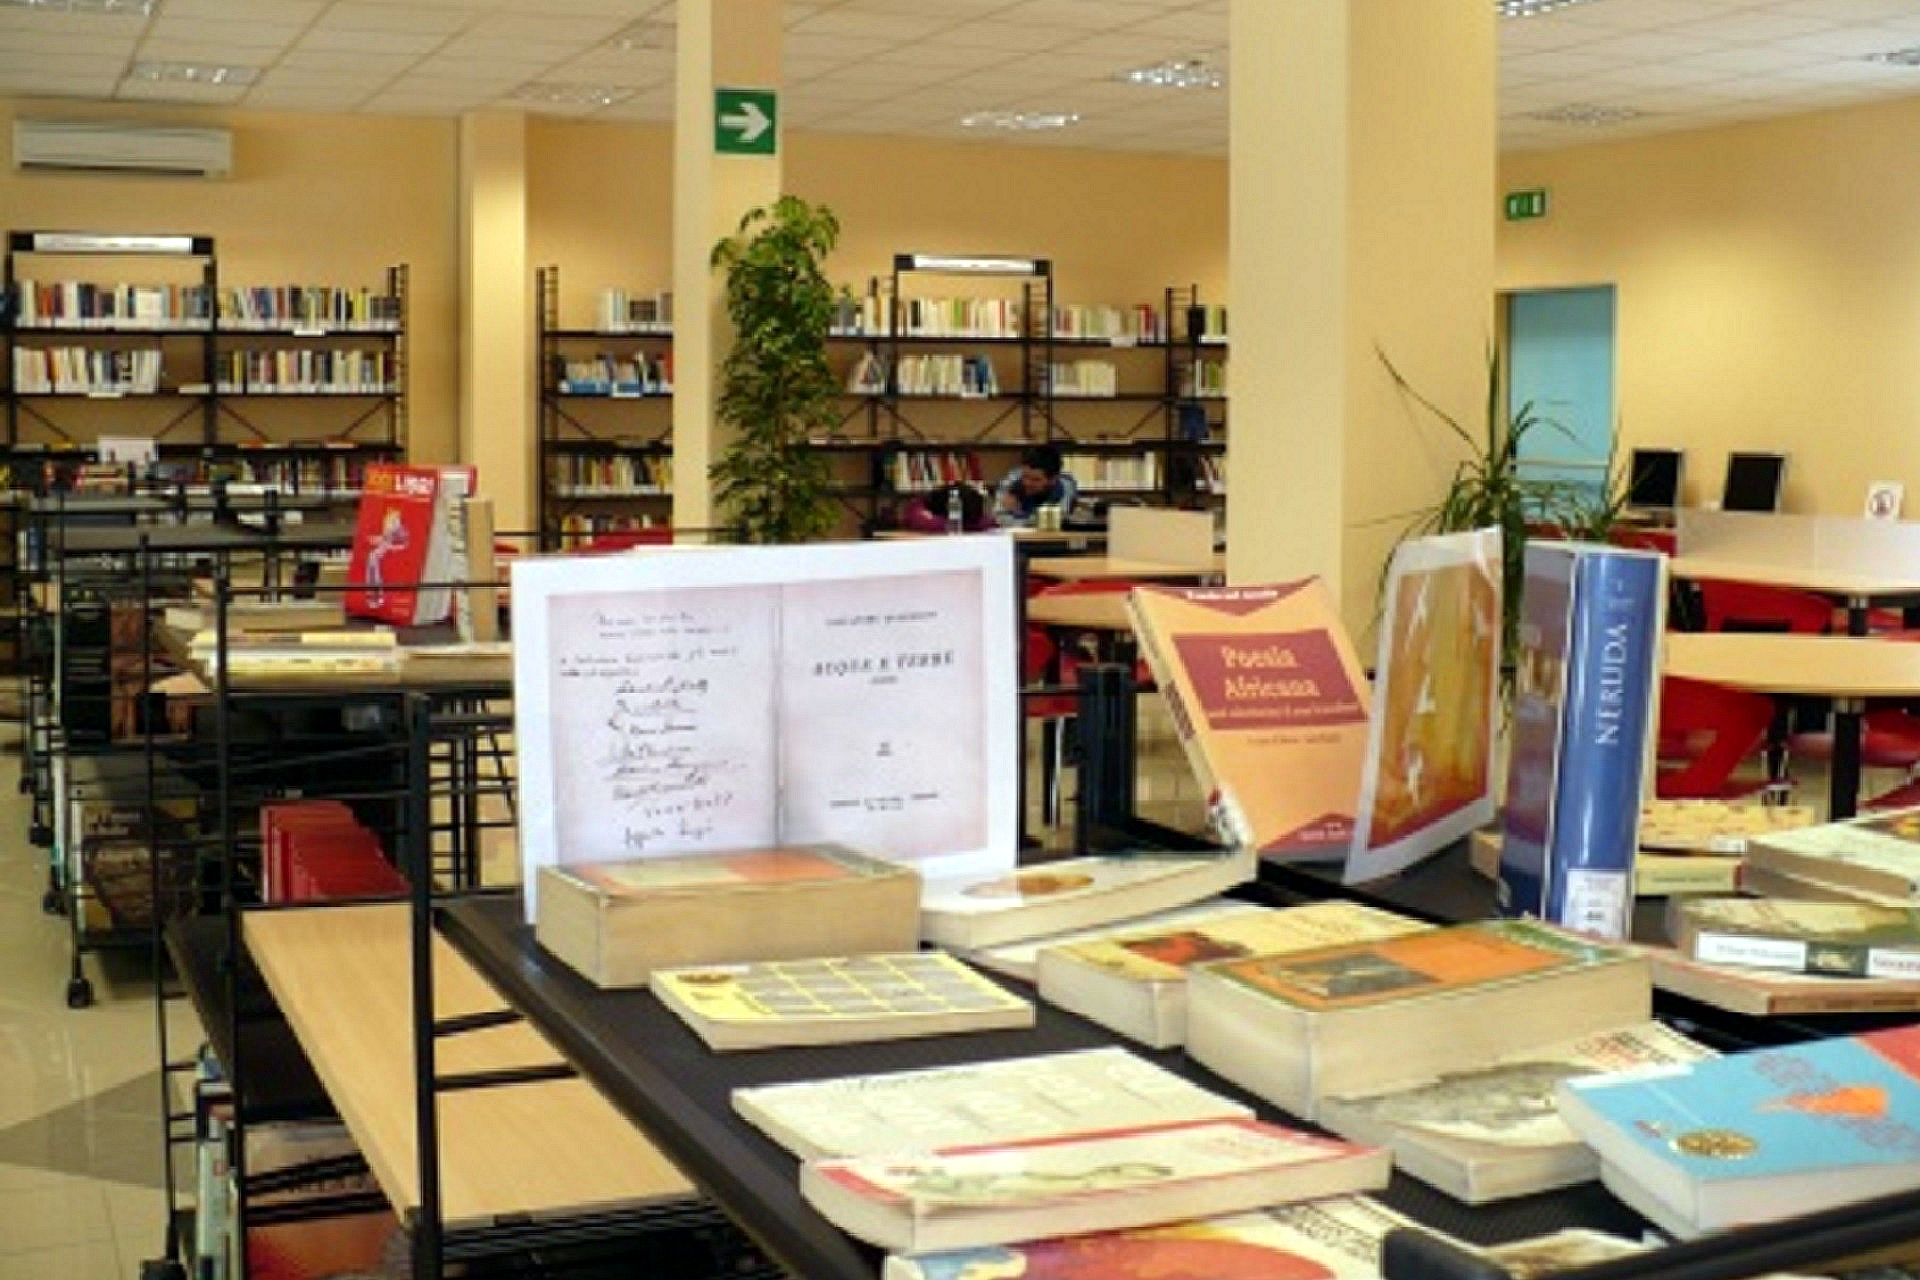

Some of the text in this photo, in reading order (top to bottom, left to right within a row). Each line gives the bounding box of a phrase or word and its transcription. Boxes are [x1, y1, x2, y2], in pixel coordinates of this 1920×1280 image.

[1220, 645, 1299, 668] Poesia
[1224, 675, 1322, 700] Africana
[1595, 624, 1628, 745] NERUDA
